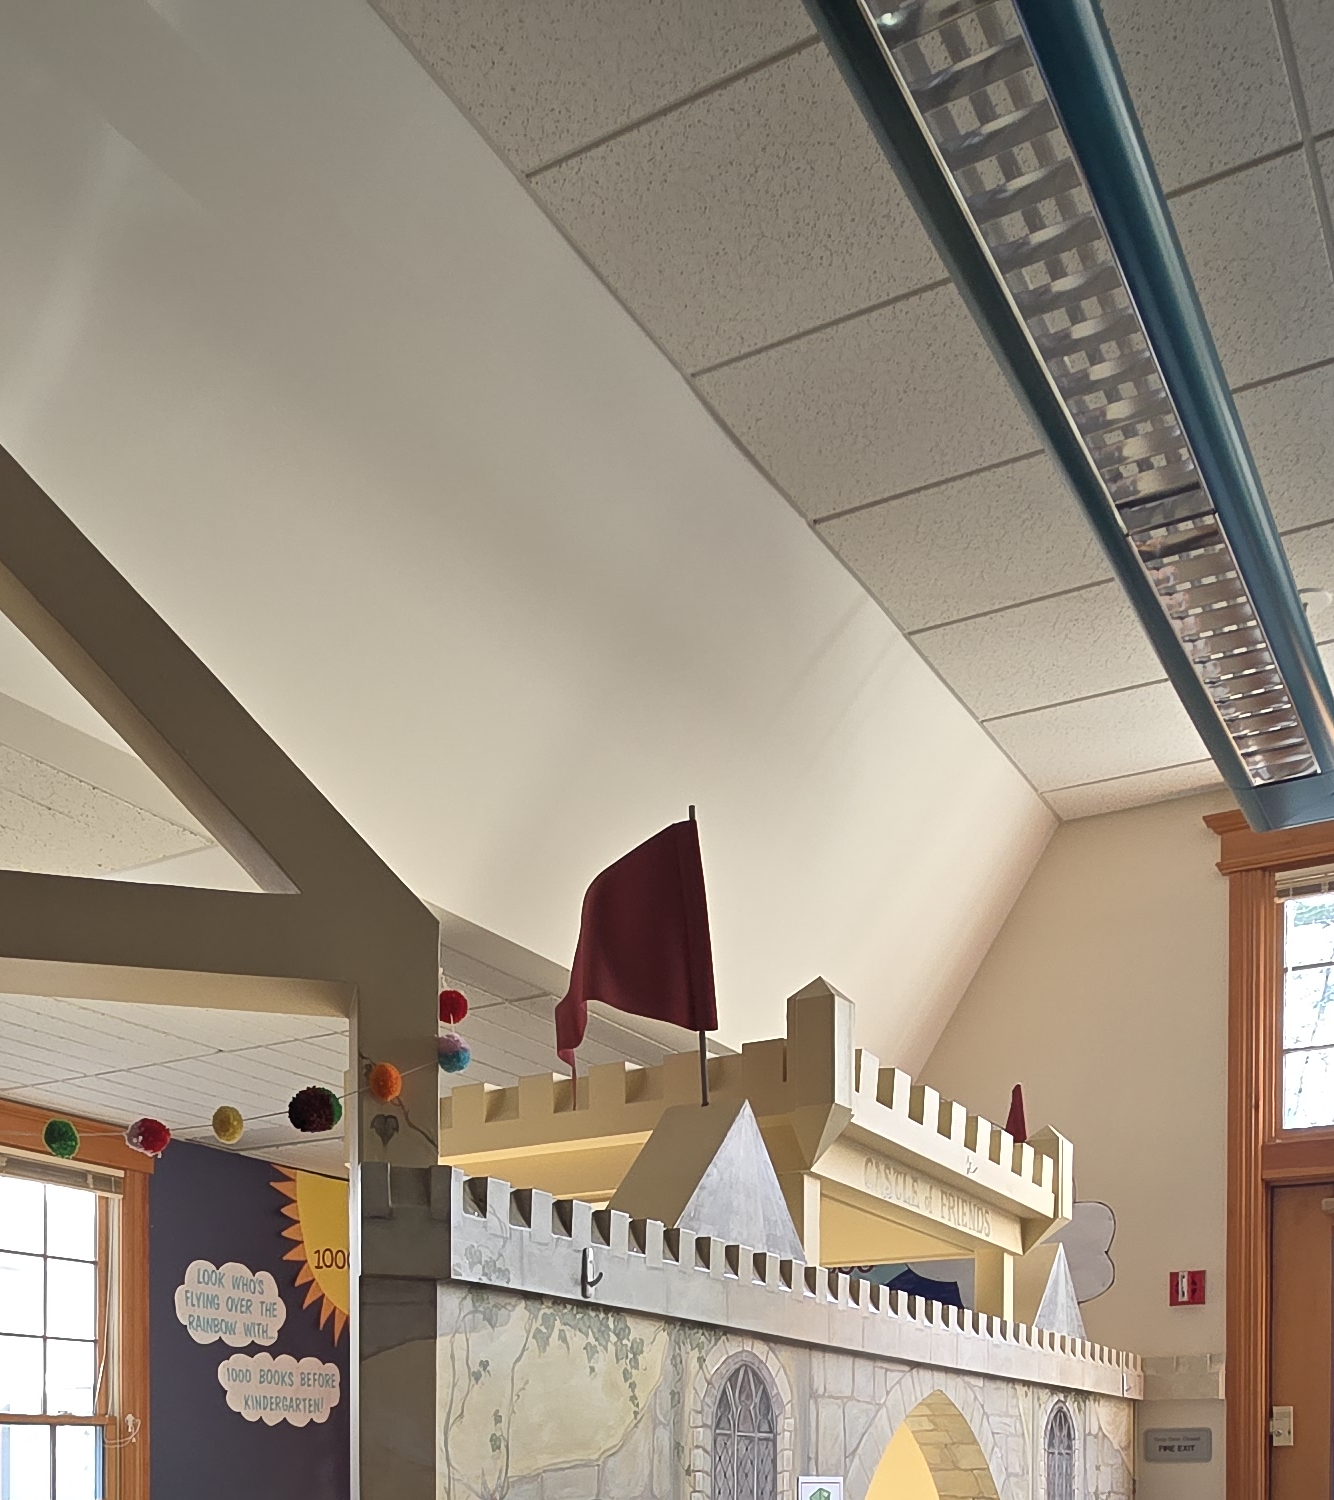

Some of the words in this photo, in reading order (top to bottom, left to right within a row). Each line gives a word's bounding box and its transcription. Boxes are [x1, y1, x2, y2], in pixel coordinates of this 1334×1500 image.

[864, 1156, 920, 1209] CASTLE
[940, 1188, 991, 1238] FRIENDS
[197, 1268, 225, 1288] LOOK
[231, 1275, 264, 1295] WHO'S
[184, 1290, 221, 1311] FLYING
[225, 1296, 252, 1315] OVER
[259, 1300, 278, 1319] THE
[187, 1314, 237, 1336] RAINBOW
[226, 1367, 252, 1383] 1000
[258, 1368, 294, 1387] BOOKS
[300, 1372, 336, 1389] BEFORE
[244, 1394, 324, 1415] KINDERGARTEN!
[1177, 1444, 1195, 1452] EXIT
